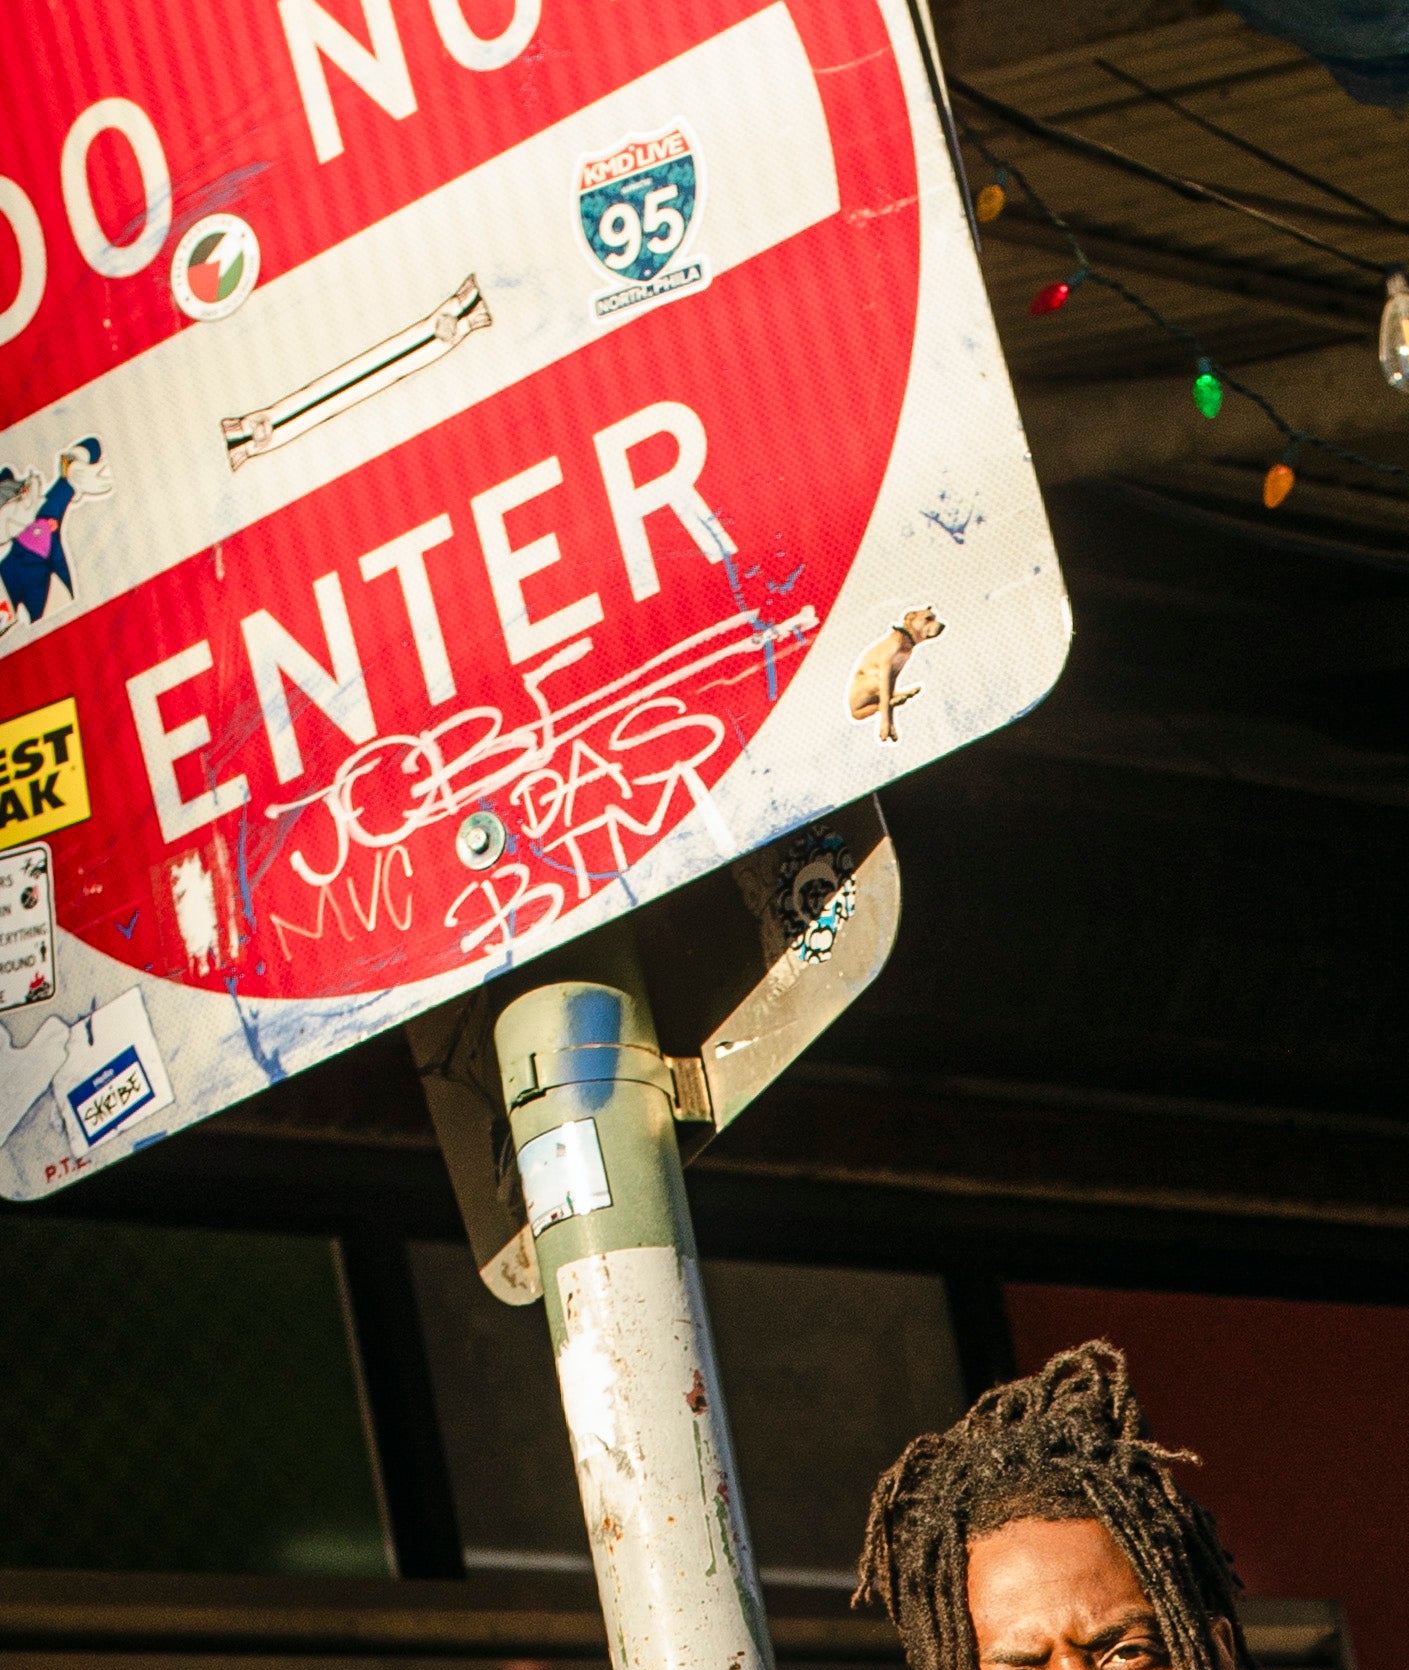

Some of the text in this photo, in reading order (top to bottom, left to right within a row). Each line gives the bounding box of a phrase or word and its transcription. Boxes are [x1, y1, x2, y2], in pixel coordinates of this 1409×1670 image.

[600, 184, 685, 270] 95
[652, 264, 700, 293] PHILA
[125, 401, 738, 844] ENTER
